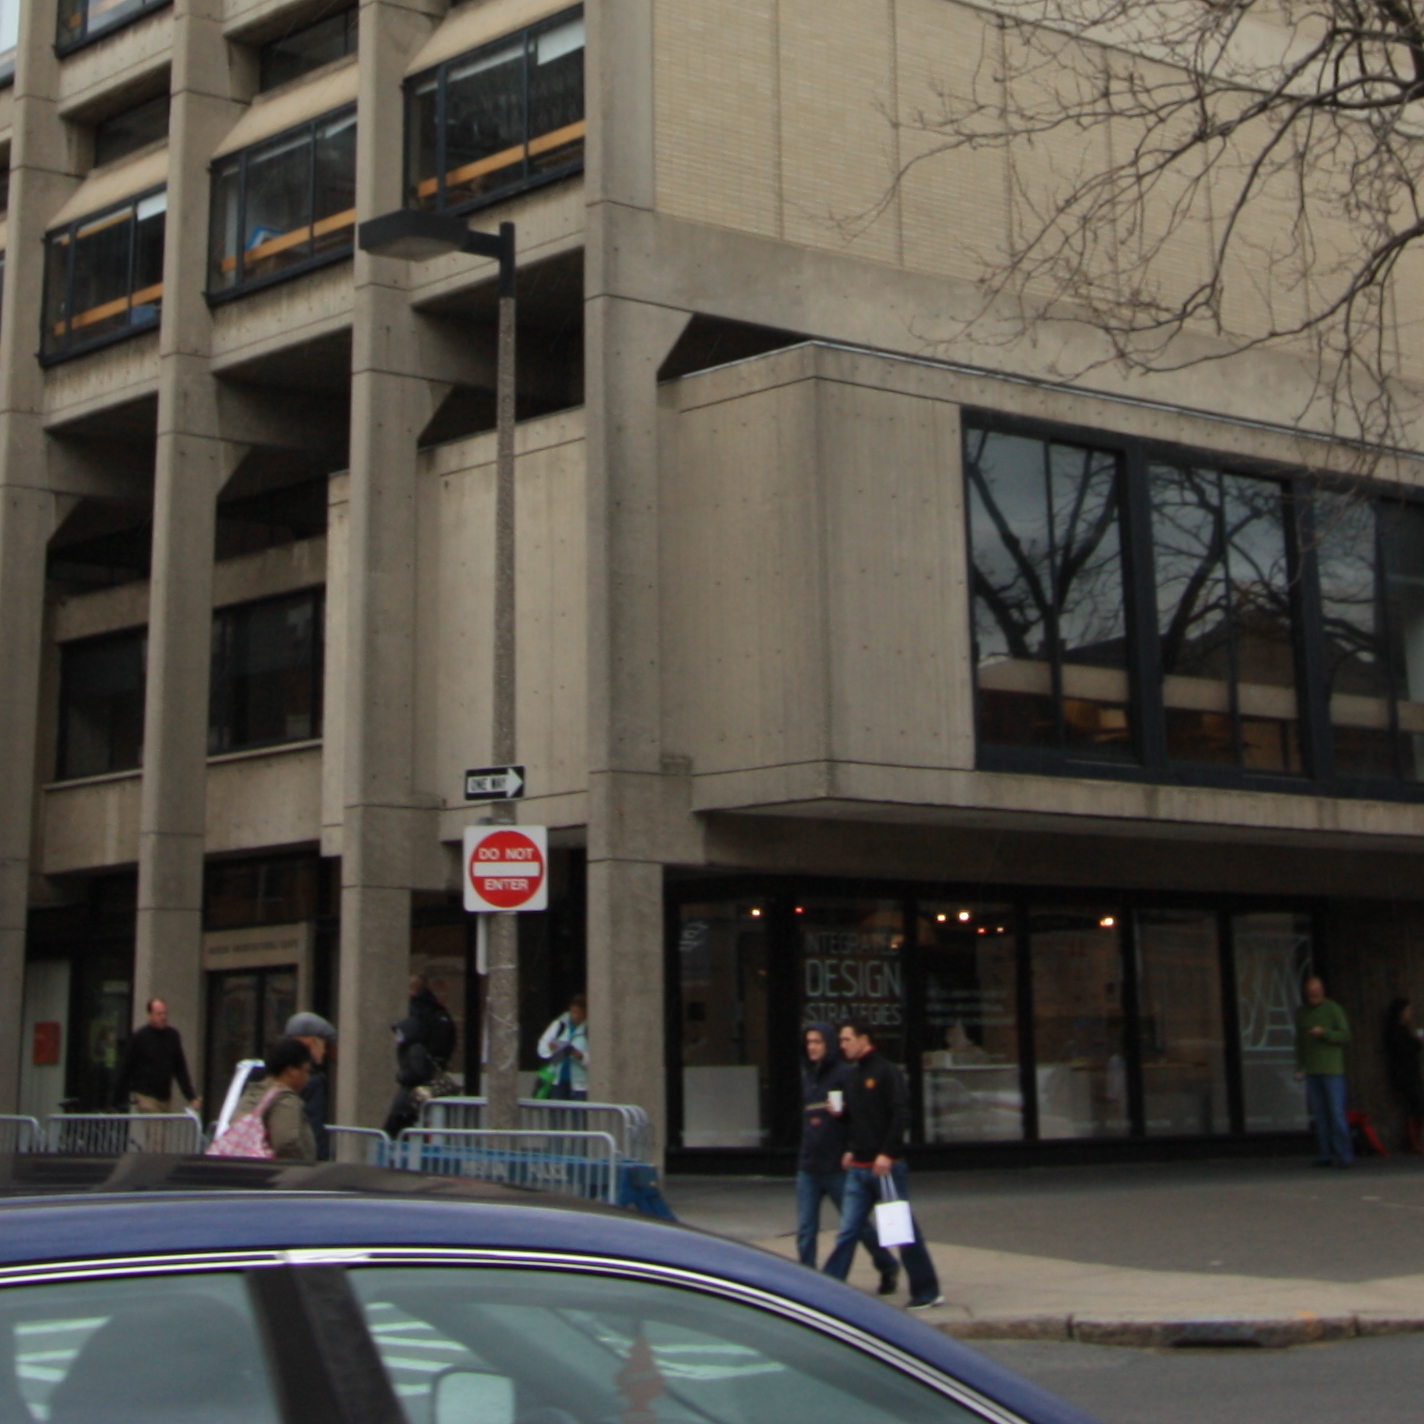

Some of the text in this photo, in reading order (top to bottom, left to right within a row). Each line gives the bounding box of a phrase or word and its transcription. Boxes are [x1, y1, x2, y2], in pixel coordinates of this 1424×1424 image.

[470, 776, 507, 792] ONE WAY
[479, 847, 534, 860] DO NOT
[484, 879, 528, 891] ENTER
[805, 958, 902, 998] DESIGN
[805, 1002, 902, 1026] STRATEGIES
